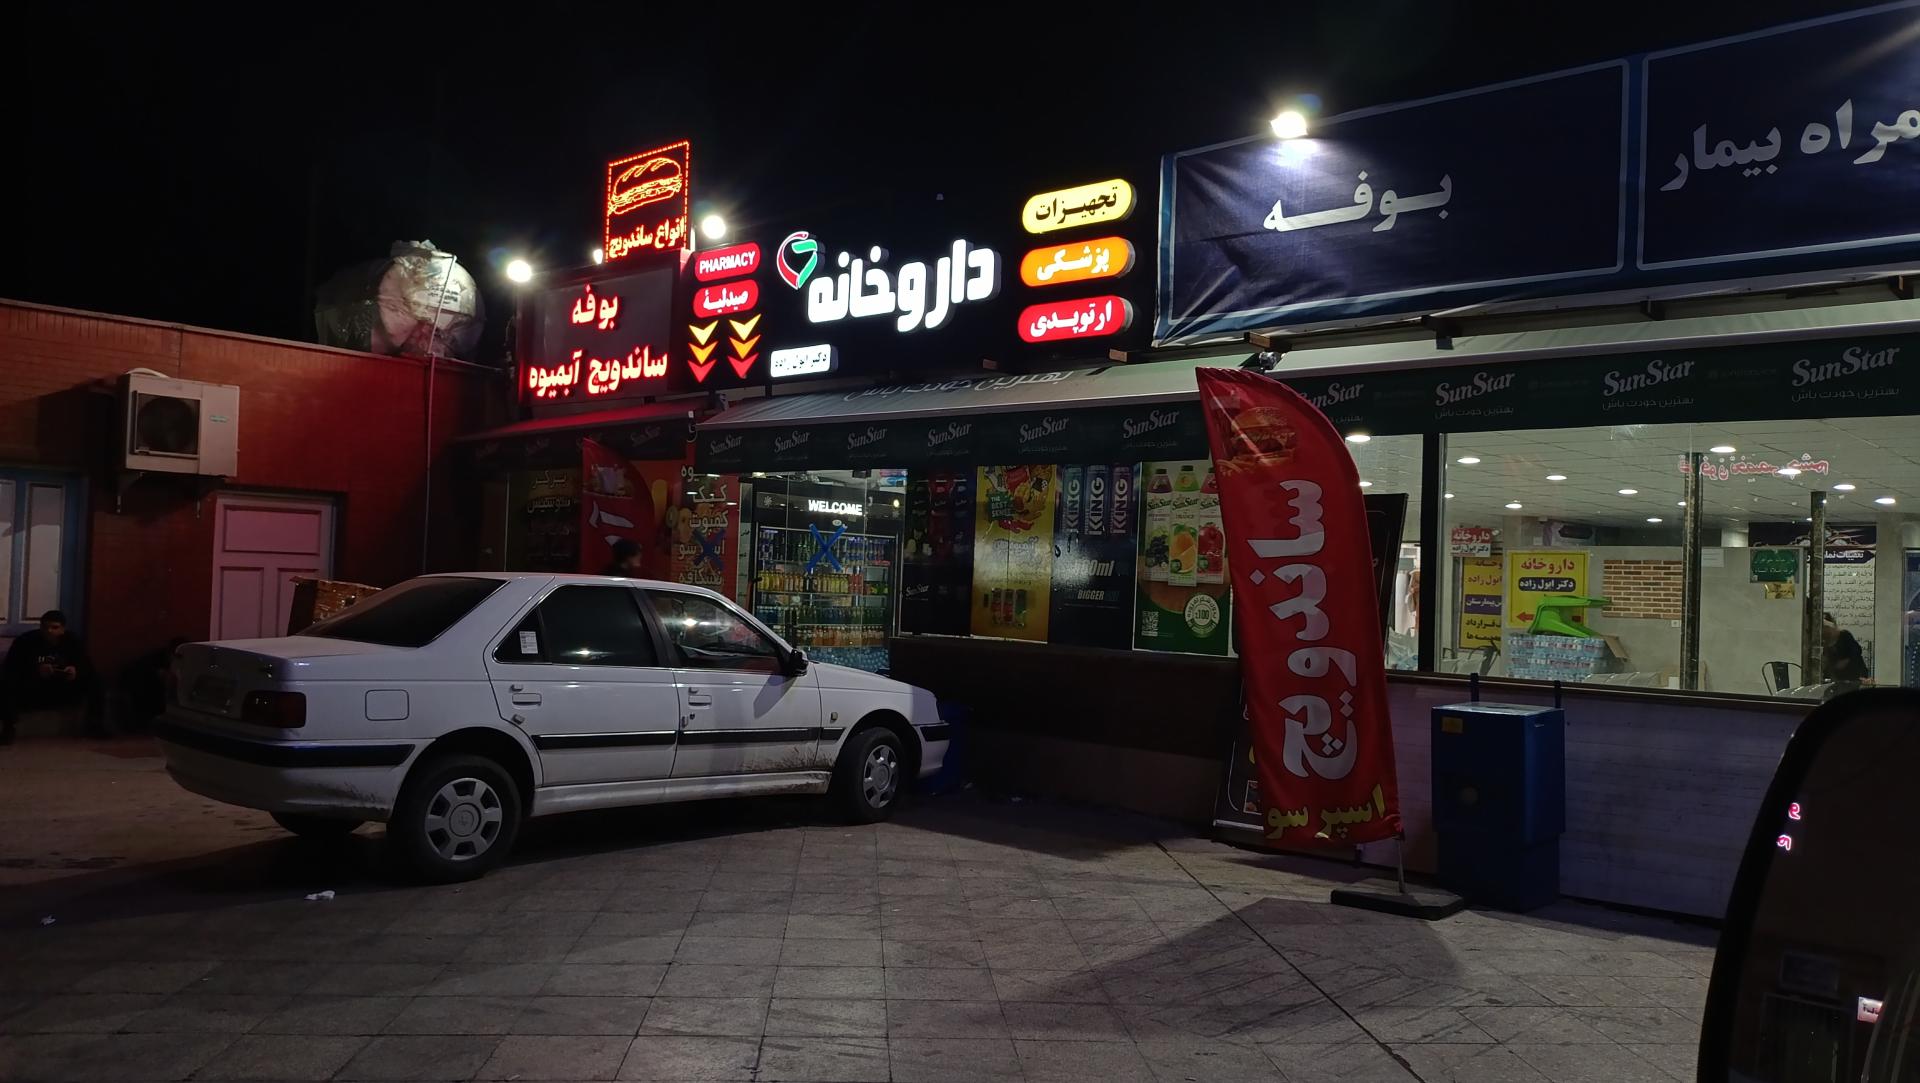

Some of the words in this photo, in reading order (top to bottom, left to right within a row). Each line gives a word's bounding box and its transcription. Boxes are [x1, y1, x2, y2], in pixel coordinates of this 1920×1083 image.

[1800, 98, 1920, 165] مراه
[1659, 123, 1782, 192] بیمار
[1034, 185, 1118, 222] تجهیزات
[1264, 171, 1453, 233] بوفه
[609, 224, 654, 259] ساندویچ
[655, 216, 685, 249] انواع
[699, 252, 756, 274] PHARMACY
[1036, 247, 1110, 281] پزشکی
[807, 238, 995, 333] داروخانه
[572, 284, 619, 330] بوفه
[1030, 300, 1113, 338] ارتوپدی
[529, 349, 583, 398] آبمیوه
[588, 346, 668, 394] ساندویچ
[1603, 359, 1695, 397] SunStar
[1791, 346, 1900, 387] SunStar
[1435, 371, 1516, 407] SunStar
[775, 430, 810, 453] SunStar
[848, 426, 887, 450] SunStar
[927, 422, 972, 447] SunStar
[1019, 416, 1070, 443] SunStar
[1122, 409, 1180, 439] SunStar
[808, 500, 863, 516] WELCOME
[1088, 477, 1104, 535] KING
[1112, 479, 1128, 534] KING
[1453, 529, 1490, 544] داروخانه
[1520, 557, 1575, 574] داروخانه
[1077, 589, 1105, 601] BIGGER
[1556, 579, 1574, 590] دکتر
[1247, 479, 1358, 780] ساندویچ
